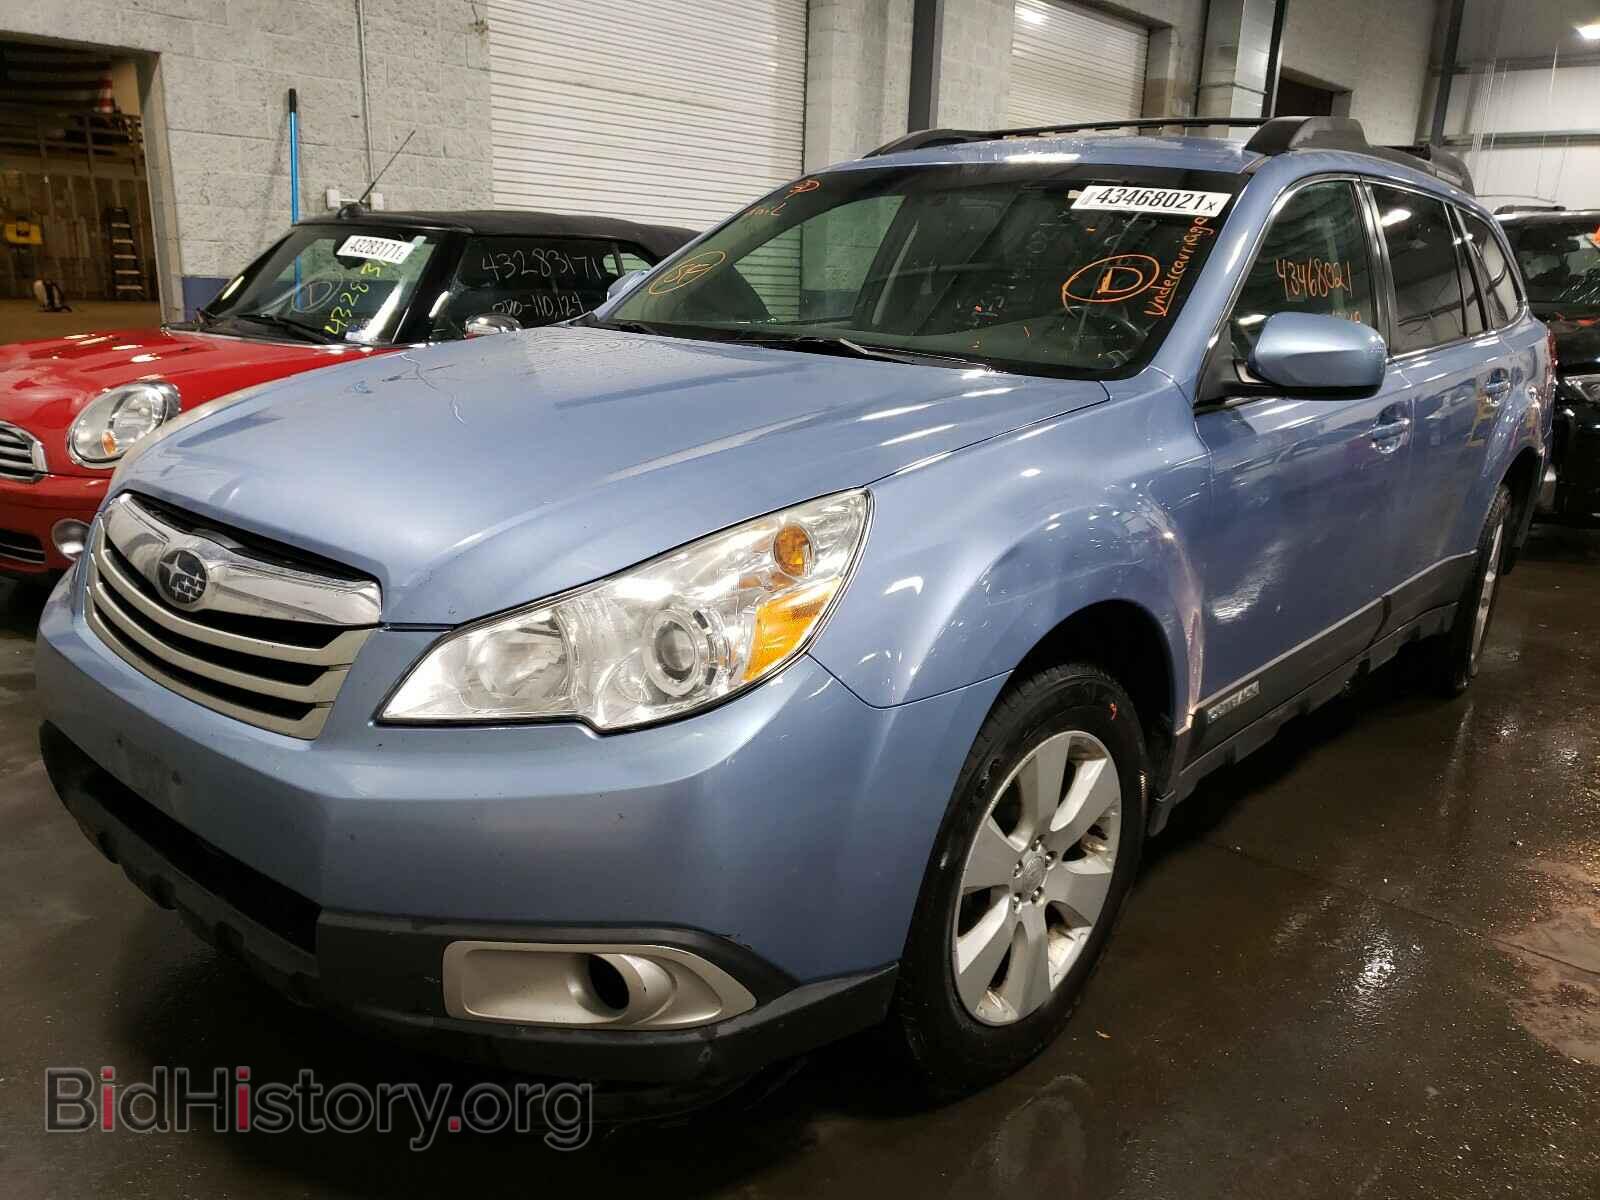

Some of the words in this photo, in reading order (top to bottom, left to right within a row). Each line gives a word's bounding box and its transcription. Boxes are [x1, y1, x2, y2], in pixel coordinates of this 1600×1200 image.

[1096, 187, 1207, 211] 43468021
[482, 248, 602, 281] 43283171
[1276, 256, 1353, 302] 43468021
